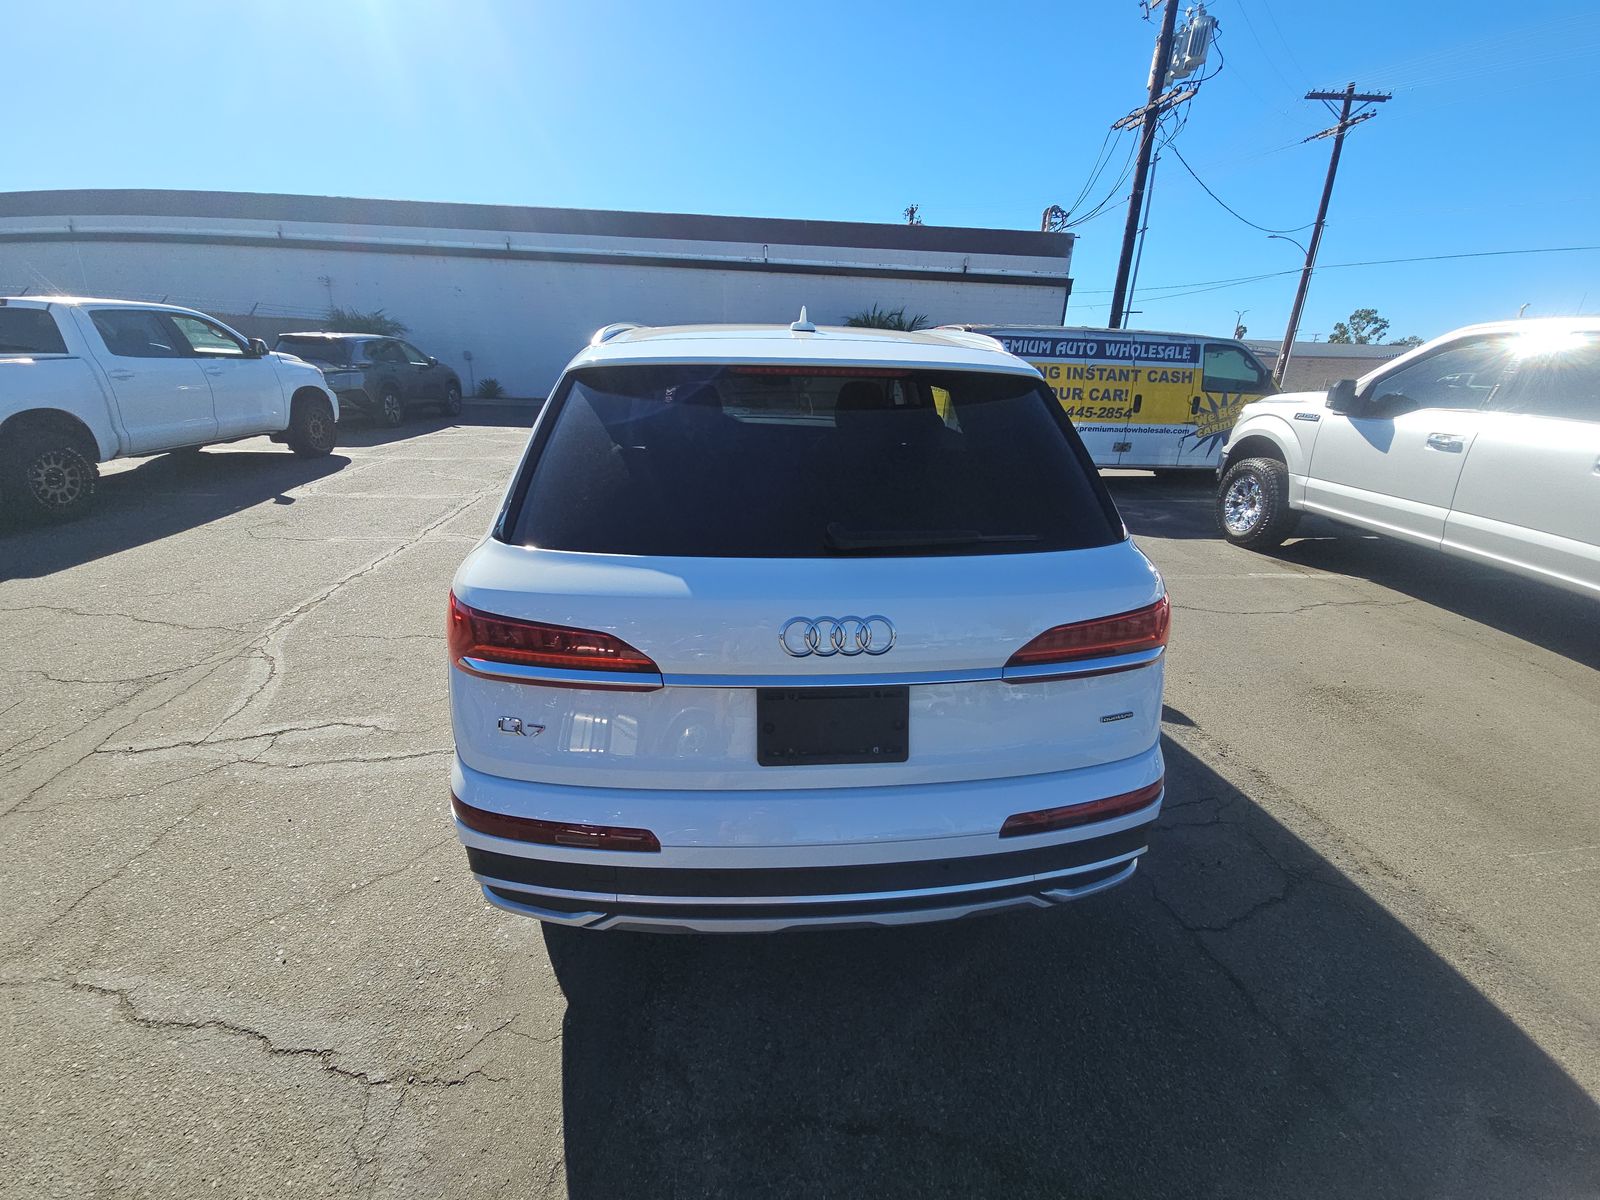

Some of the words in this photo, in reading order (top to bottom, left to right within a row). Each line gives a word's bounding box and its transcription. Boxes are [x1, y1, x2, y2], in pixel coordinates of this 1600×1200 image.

[1002, 339, 1052, 355] EMIUM
[1055, 342, 1098, 356] AUTO
[1105, 343, 1192, 360] WHOLESALE
[1036, 365, 1061, 380] NG
[1066, 367, 1142, 382] INSTANT
[1147, 370, 1193, 384] CASH
[1089, 388, 1129, 402] CAR!
[1066, 406, 1133, 419] 445-2854
[1076, 425, 1190, 434] .premiumautowholesale.com
